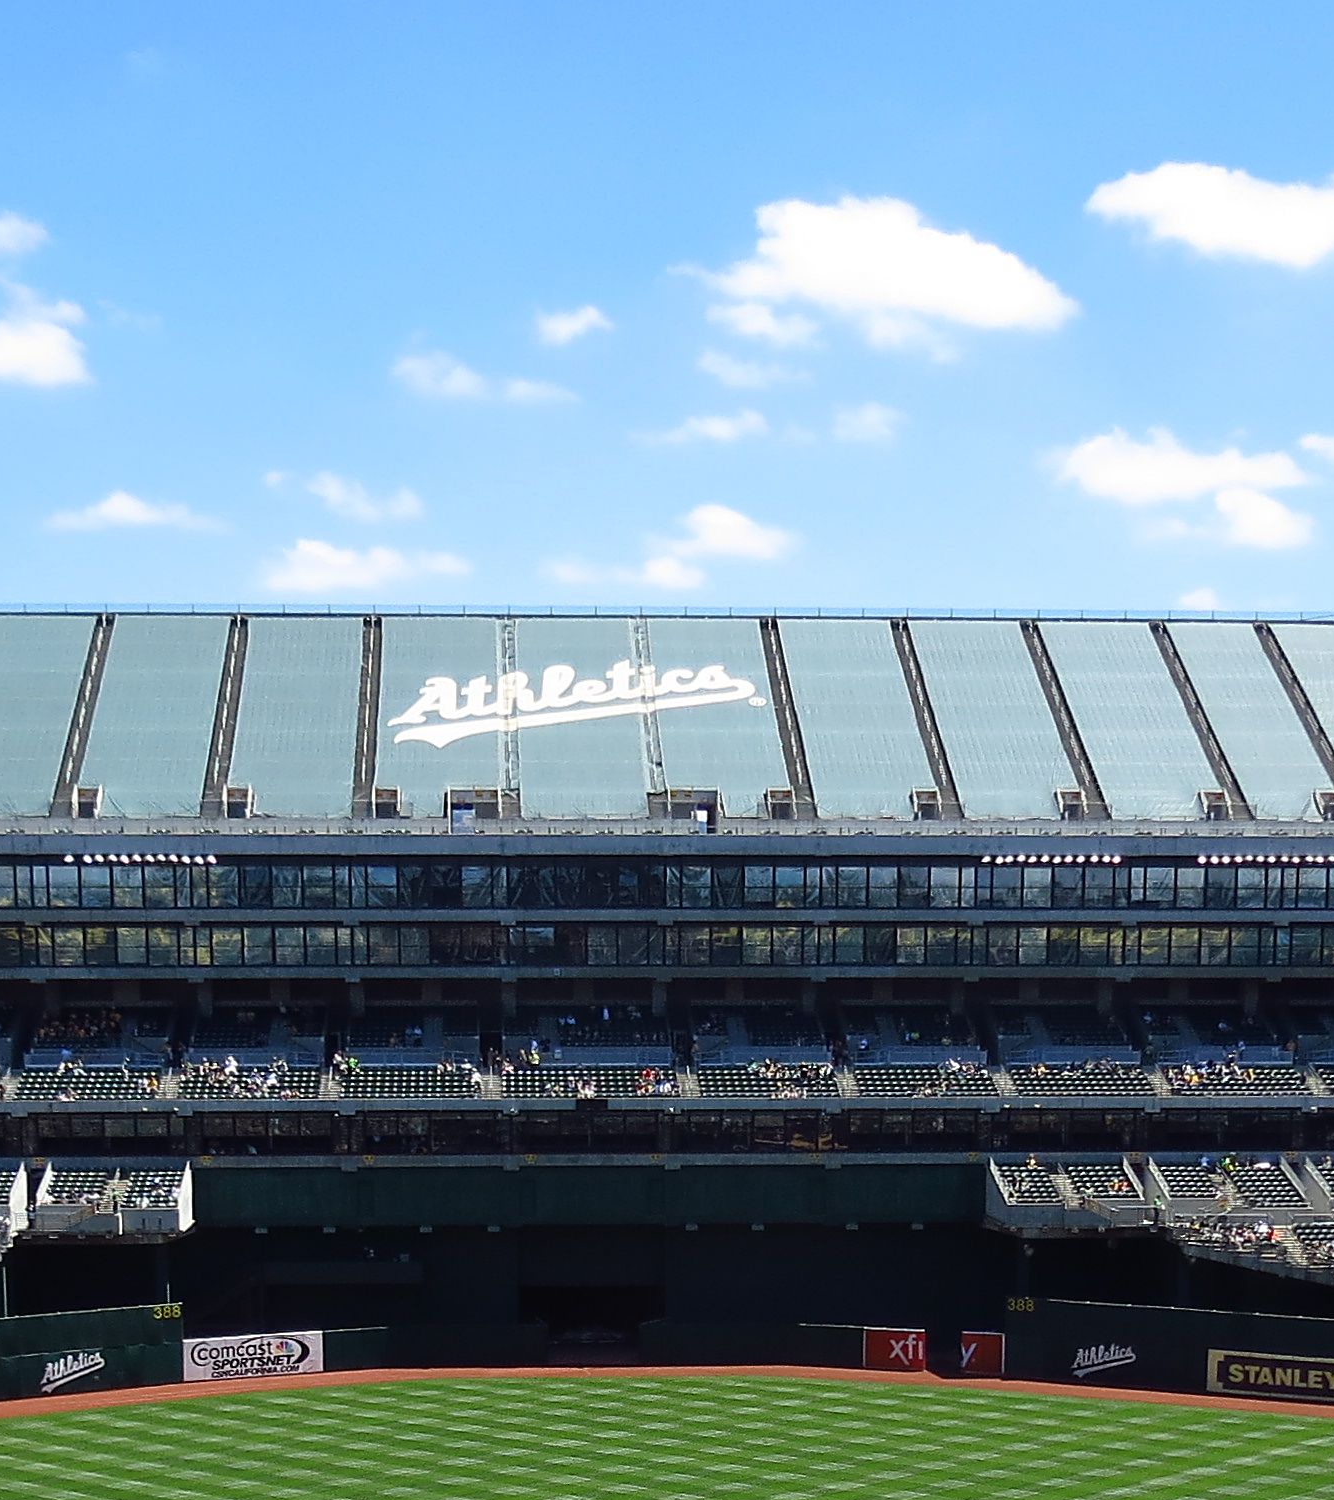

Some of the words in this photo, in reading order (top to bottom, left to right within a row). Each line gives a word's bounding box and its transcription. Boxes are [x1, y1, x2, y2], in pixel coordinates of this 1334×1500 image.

[388, 660, 755, 748] Athletics
[153, 1305, 182, 1321] 388
[1007, 1298, 1035, 1312] 388
[212, 1354, 295, 1371] SPORTSNET
[1072, 1342, 1137, 1378] Athletics
[41, 1350, 105, 1393] Athletics
[211, 1365, 300, 1378] CSNCALIFORNIA.COM
